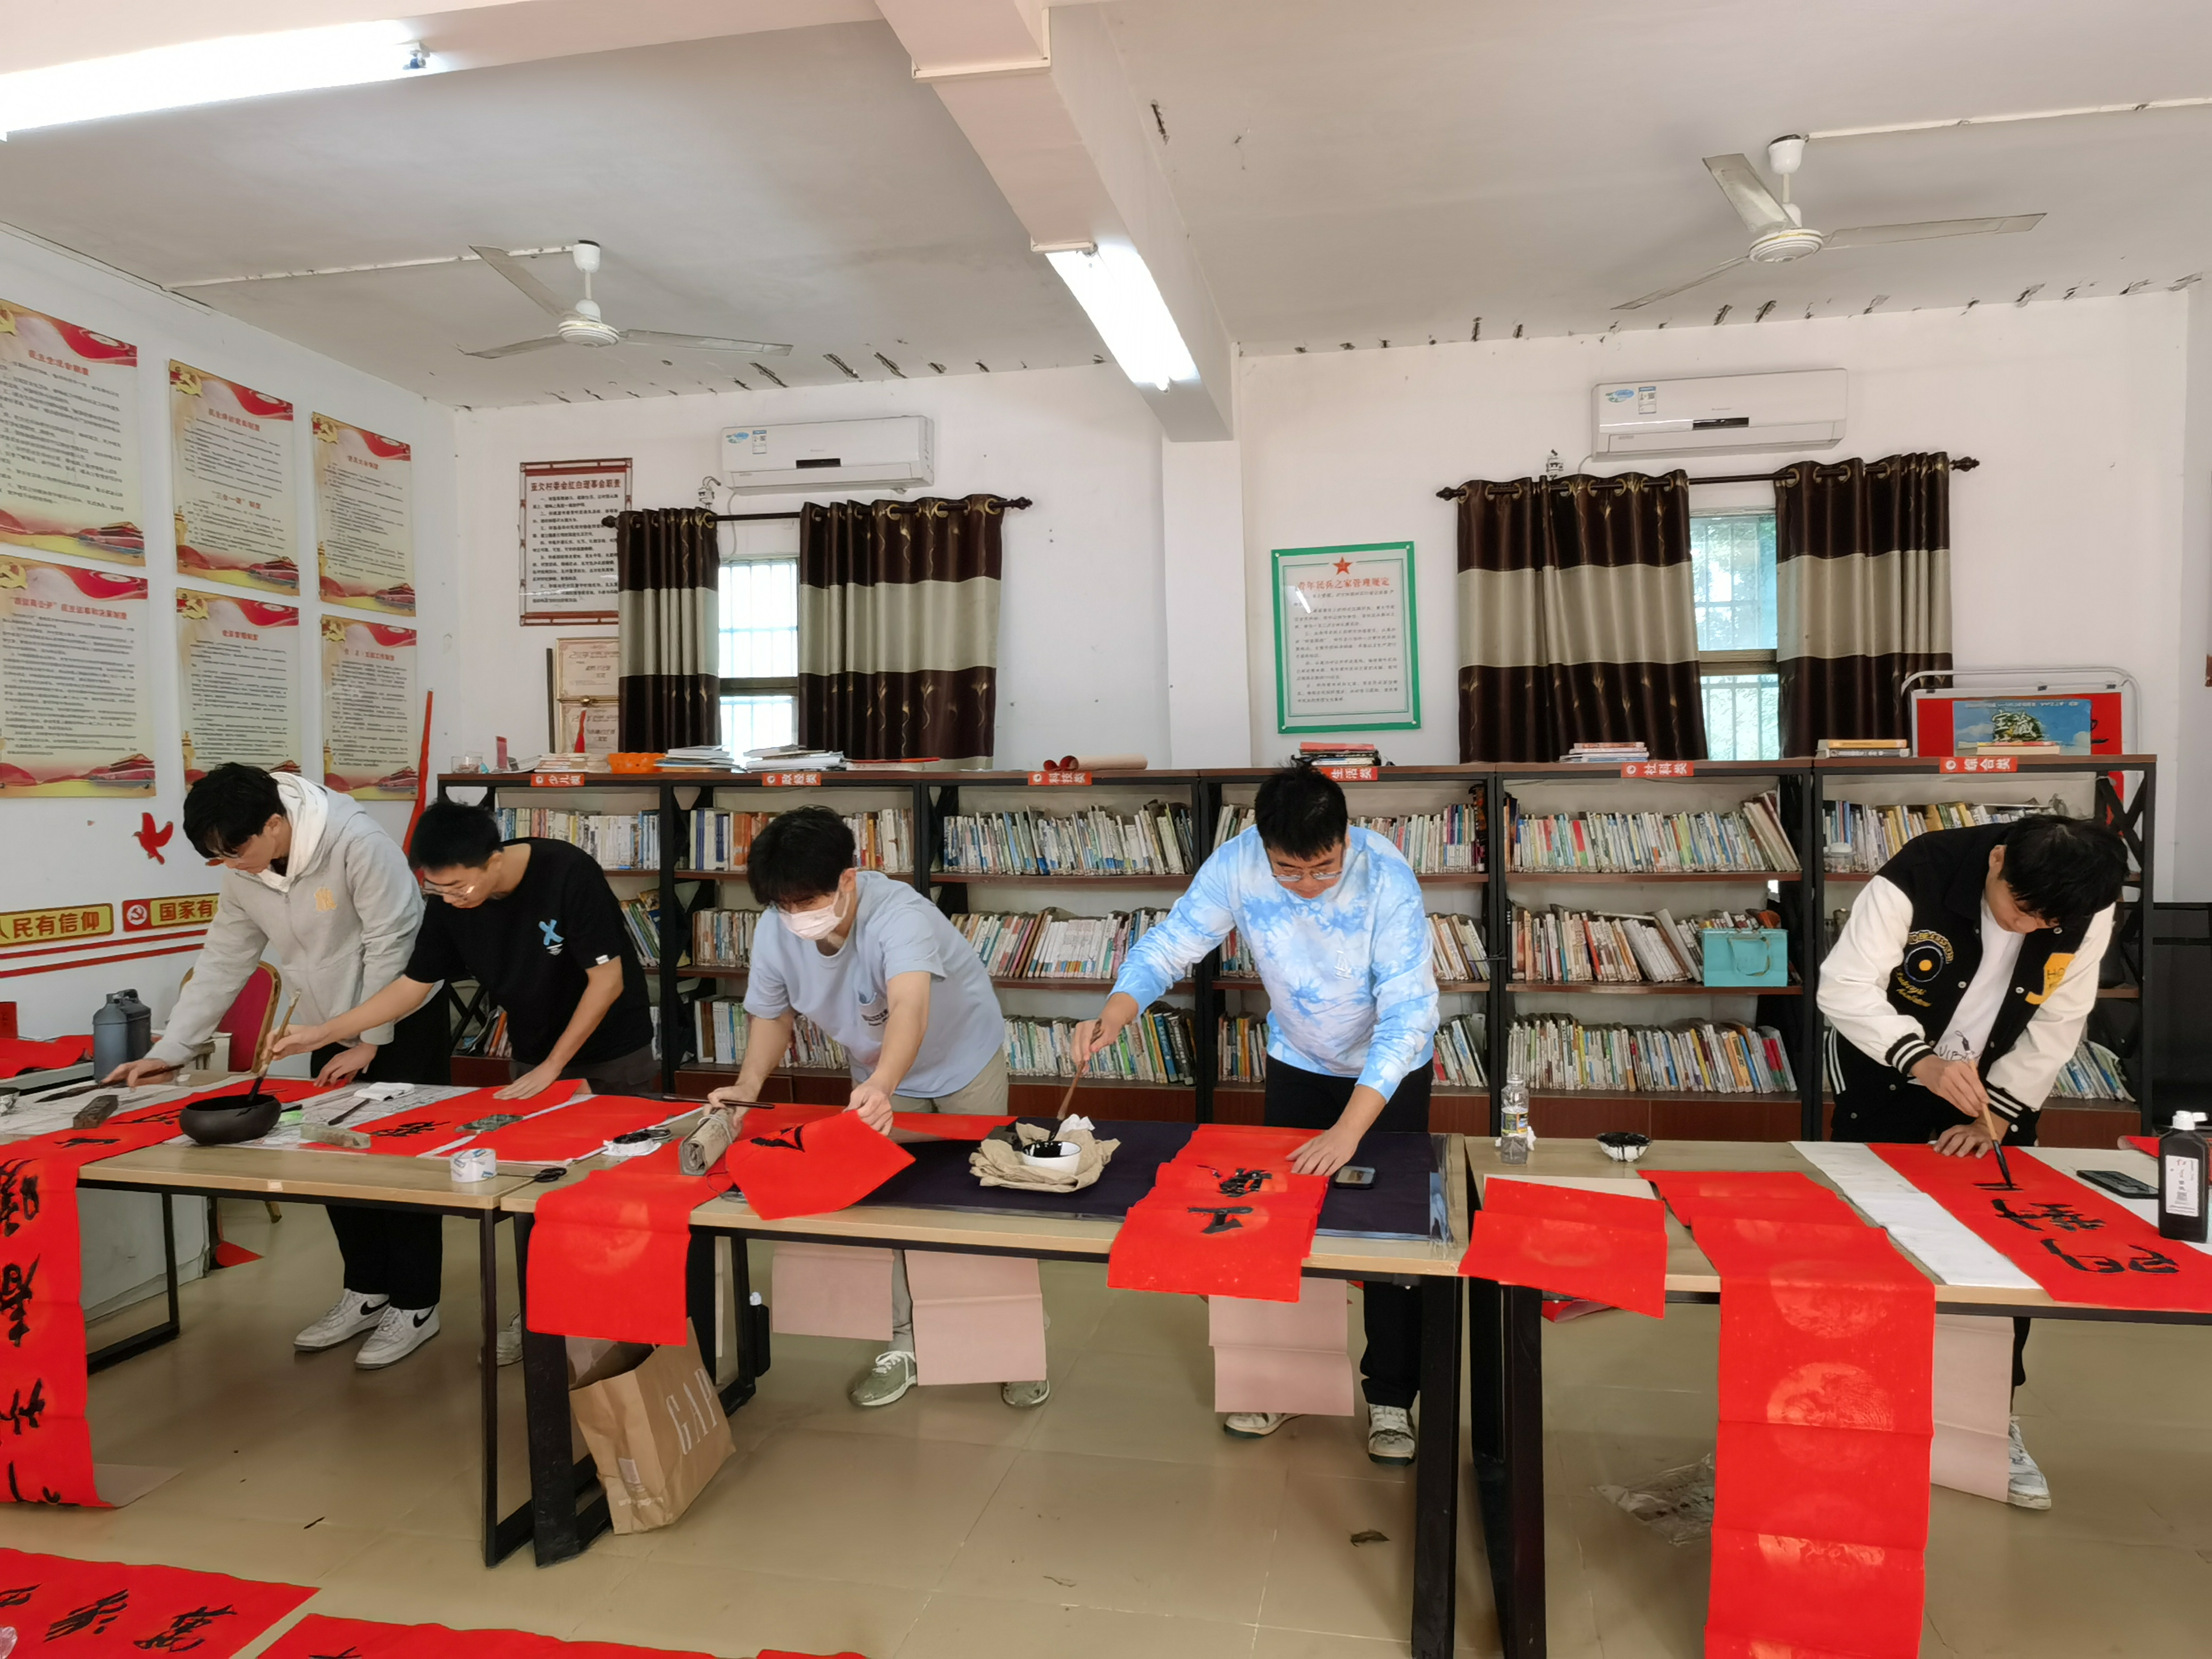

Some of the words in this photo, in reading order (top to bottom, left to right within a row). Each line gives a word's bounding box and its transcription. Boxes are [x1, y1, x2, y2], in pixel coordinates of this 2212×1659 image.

[1298, 577, 1389, 592] 青年民兵之家管理规定
[1644, 762, 1687, 775] 社科类
[1964, 758, 2010, 771] 综合类
[548, 774, 581, 785] 少儿类
[1048, 772, 1086, 783] 科技类
[1331, 768, 1372, 779] 生活类
[160, 899, 218, 921] 国家有
[665, 1368, 719, 1456] GAP
